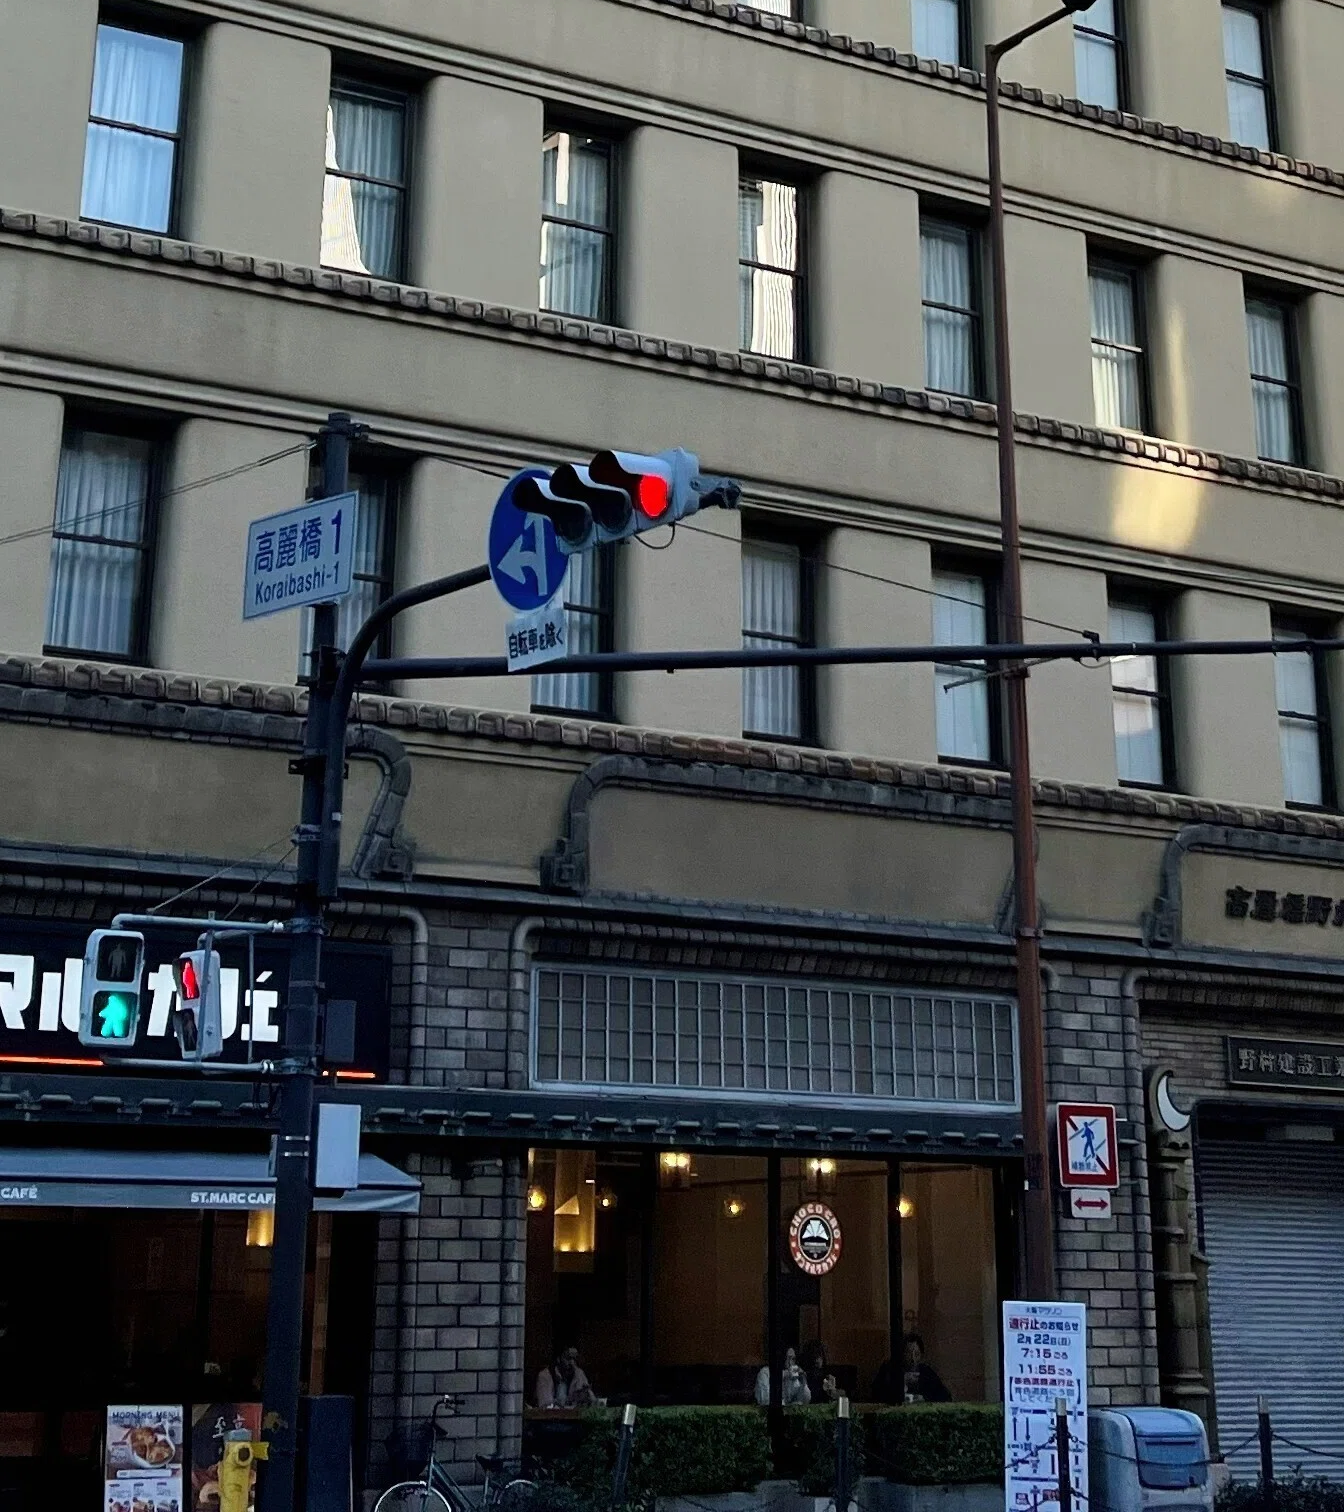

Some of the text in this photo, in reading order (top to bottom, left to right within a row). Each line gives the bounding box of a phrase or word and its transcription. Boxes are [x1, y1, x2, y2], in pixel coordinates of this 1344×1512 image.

[254, 560, 340, 606] Koraibashi-1
[508, 620, 564, 660] 自転車を除く
[0, 1184, 38, 1200] CAFÉ
[190, 1191, 246, 1205] ST.MARC
